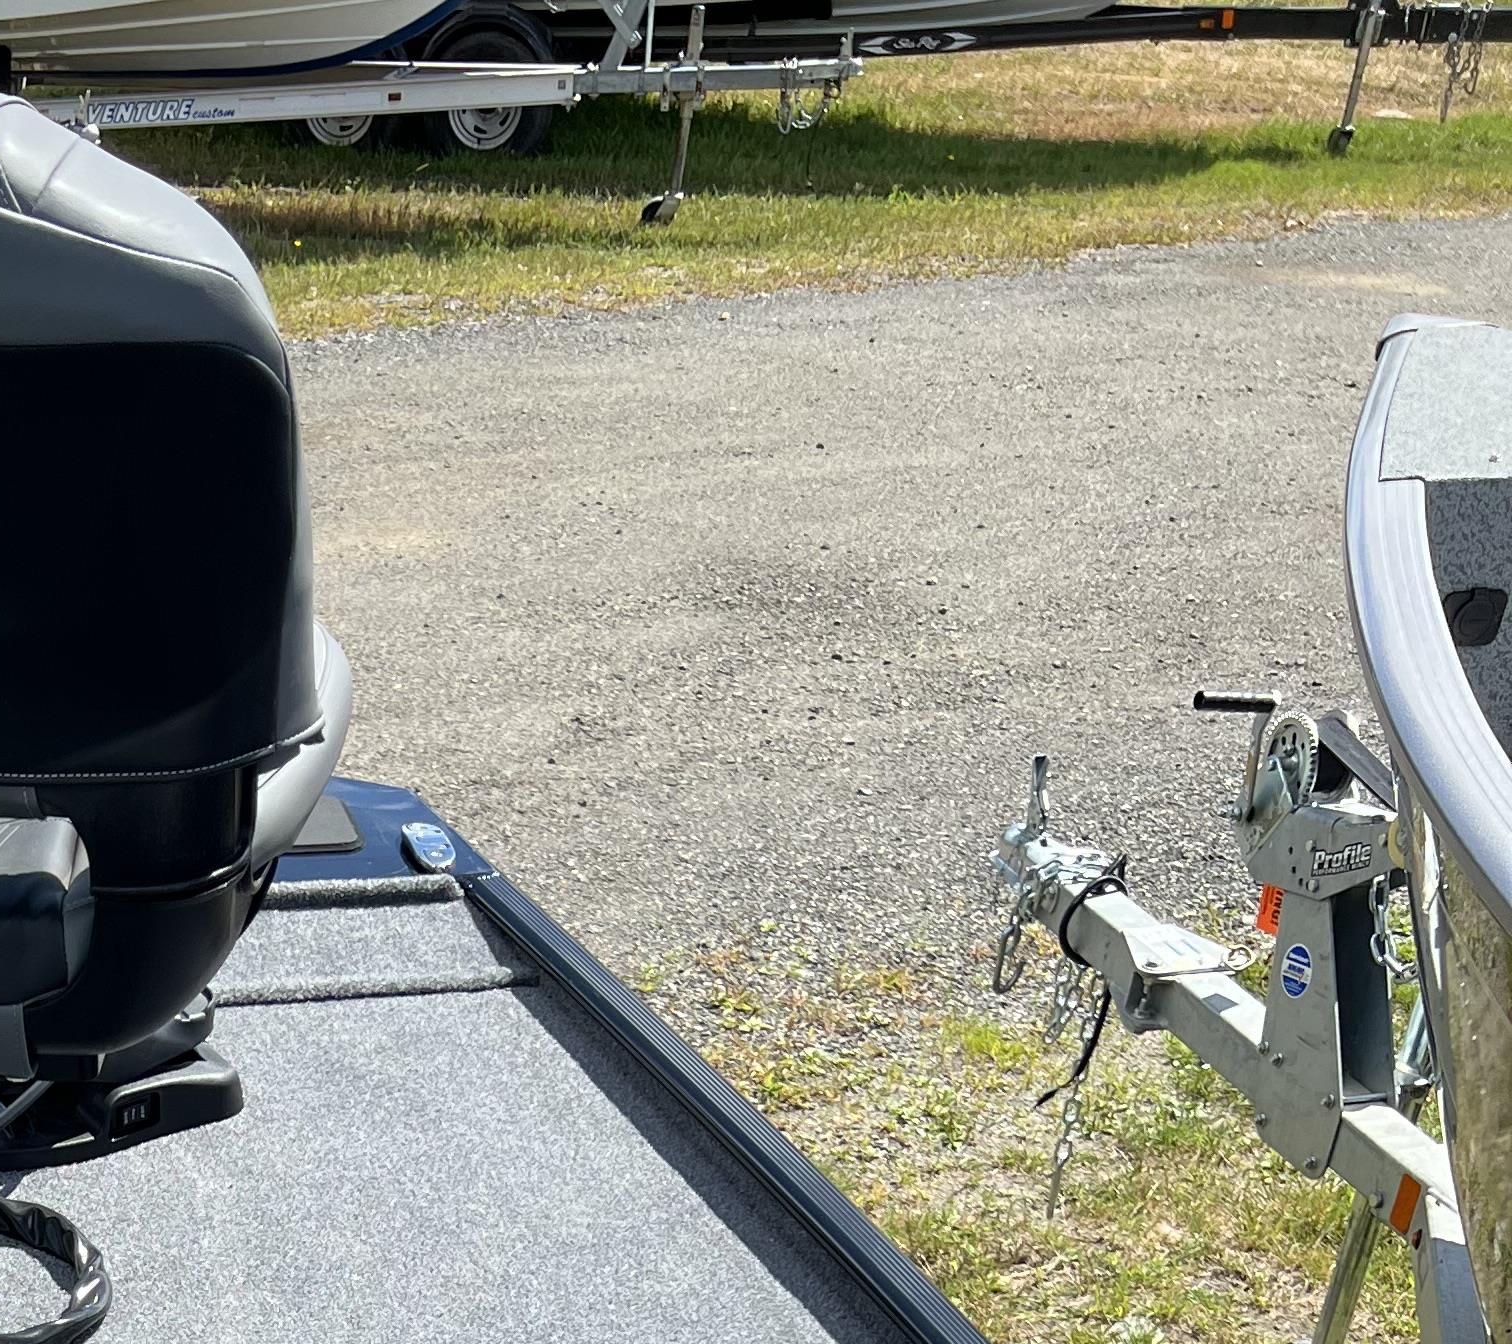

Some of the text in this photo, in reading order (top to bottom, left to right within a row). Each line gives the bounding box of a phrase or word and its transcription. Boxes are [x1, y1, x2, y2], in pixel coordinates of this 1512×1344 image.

[87, 98, 236, 125] VENTURE custom
[1313, 843, 1371, 870] Profile
